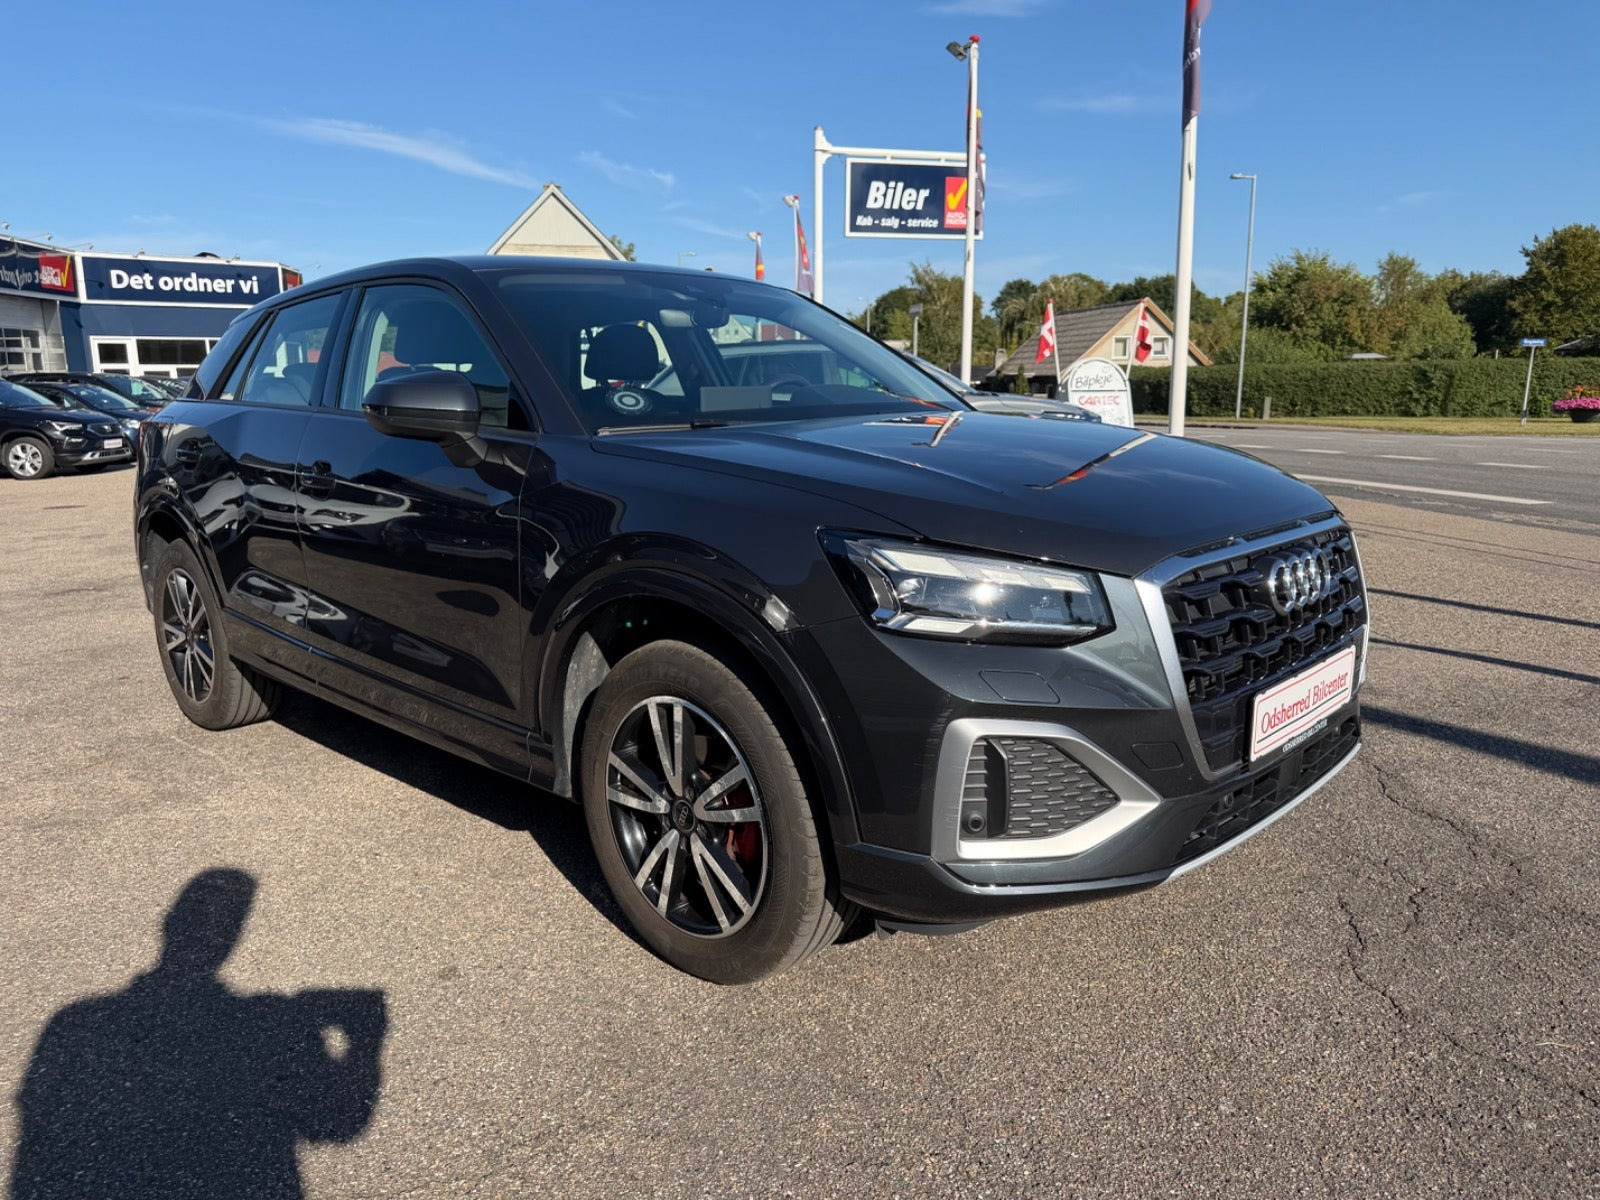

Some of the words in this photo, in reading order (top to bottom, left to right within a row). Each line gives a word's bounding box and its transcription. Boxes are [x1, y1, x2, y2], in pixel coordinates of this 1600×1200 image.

[866, 181, 930, 210] Biler
[880, 216, 900, 229] salg
[907, 217, 938, 228] service
[110, 270, 154, 291] Det
[158, 272, 235, 294] ordner
[239, 276, 259, 294] vi
[1261, 690, 1311, 734] Odsherred
[1312, 672, 1348, 705] Bilcenter
